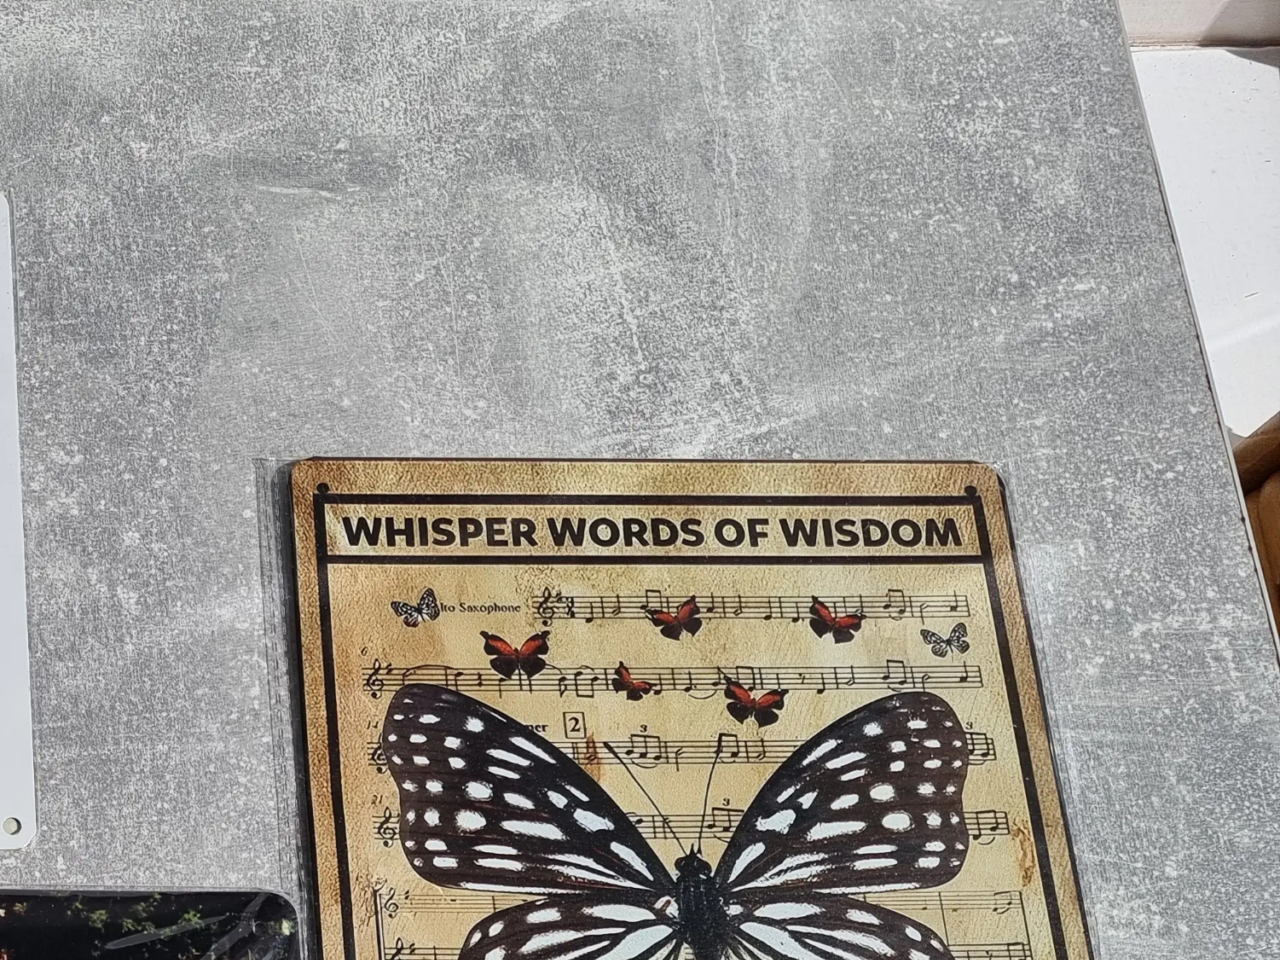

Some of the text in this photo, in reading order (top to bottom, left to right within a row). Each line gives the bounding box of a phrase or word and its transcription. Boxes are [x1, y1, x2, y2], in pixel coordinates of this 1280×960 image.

[341, 516, 963, 548] WHISPER WORDS OF WISDOM
[458, 602, 521, 615] Saxophone
[567, 716, 582, 733] 2
